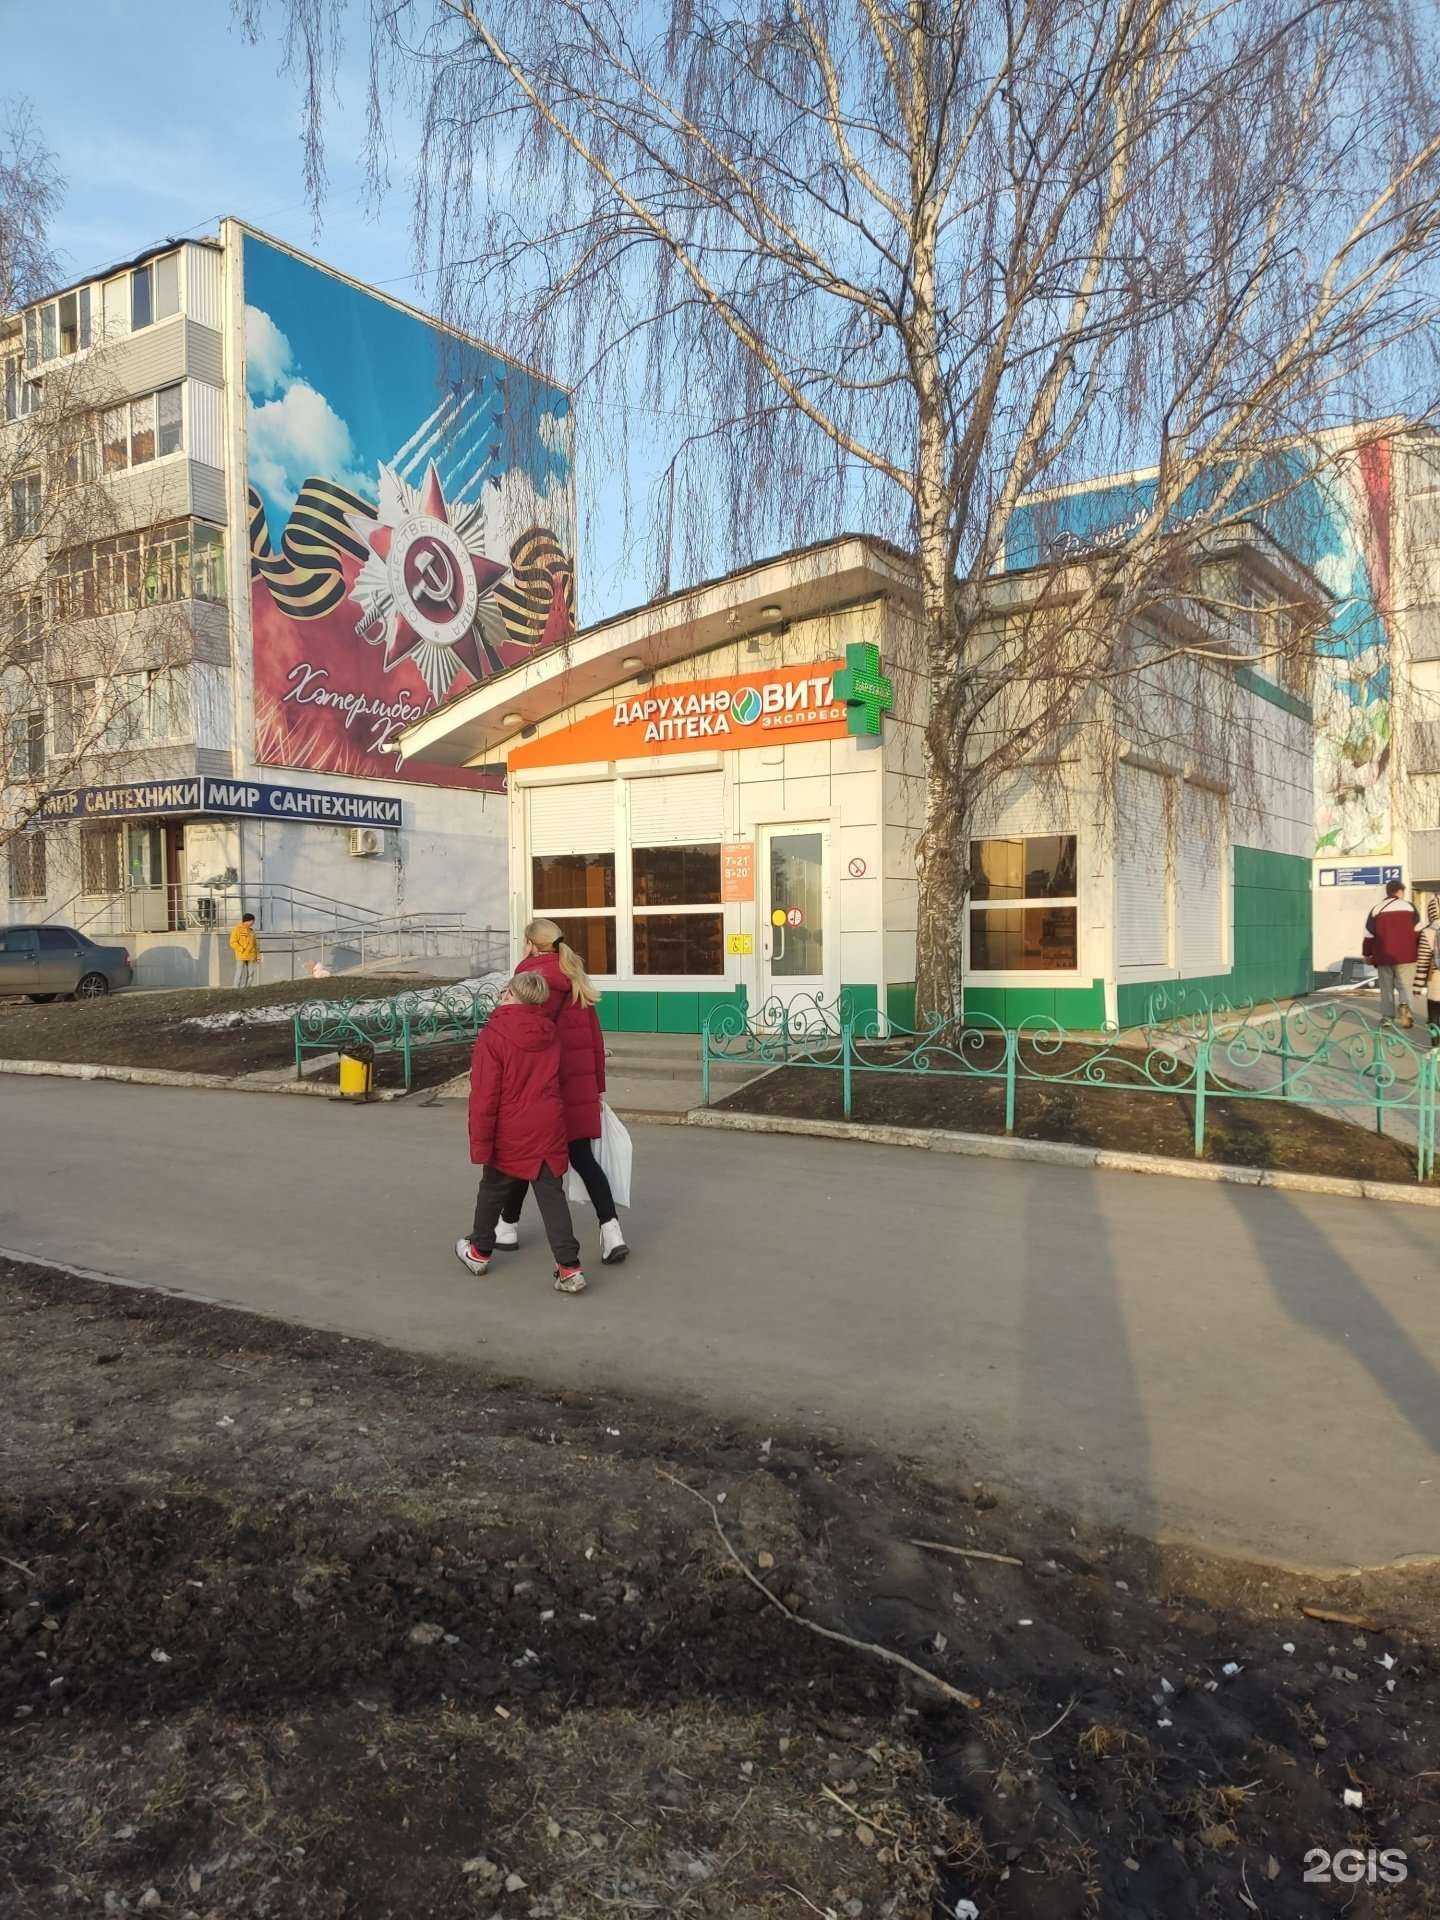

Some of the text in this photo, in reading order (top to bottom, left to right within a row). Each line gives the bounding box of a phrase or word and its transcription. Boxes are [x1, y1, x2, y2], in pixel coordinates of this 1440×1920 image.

[613, 689, 731, 726] ДАРУХАНӘ
[645, 713, 731, 742] АПТЕКА
[85, 783, 199, 812] САНТЕХНИКИ
[207, 783, 401, 821] МИР САНТЕХНИКИ
[1384, 868, 1400, 879] 12
